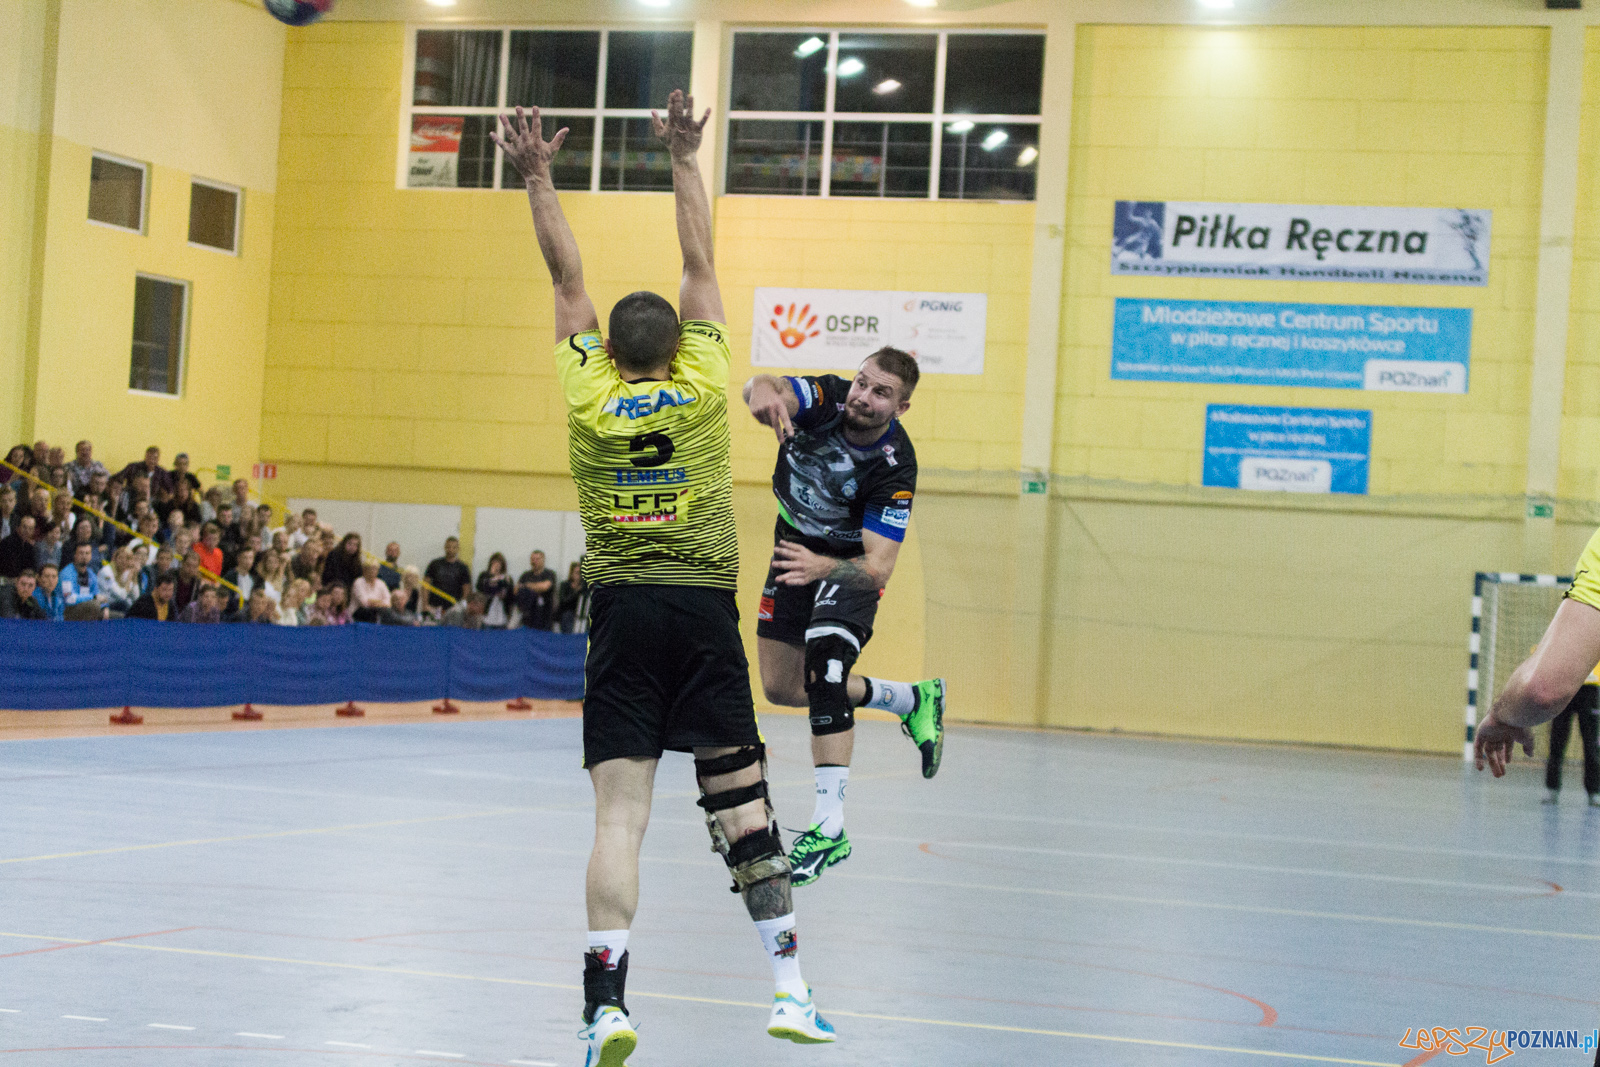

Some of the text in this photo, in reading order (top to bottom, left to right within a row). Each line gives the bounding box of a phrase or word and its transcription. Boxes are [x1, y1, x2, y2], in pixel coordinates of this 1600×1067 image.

[1171, 213, 1429, 261] Piłka Ręczna
[826, 314, 879, 334] OSPR
[1280, 310, 1365, 331] Centrum
[1368, 312, 1439, 334] Sportu
[1170, 332, 1186, 345] w
[615, 389, 697, 420] REAL
[629, 427, 676, 468] 5
[613, 492, 678, 510] LFP
